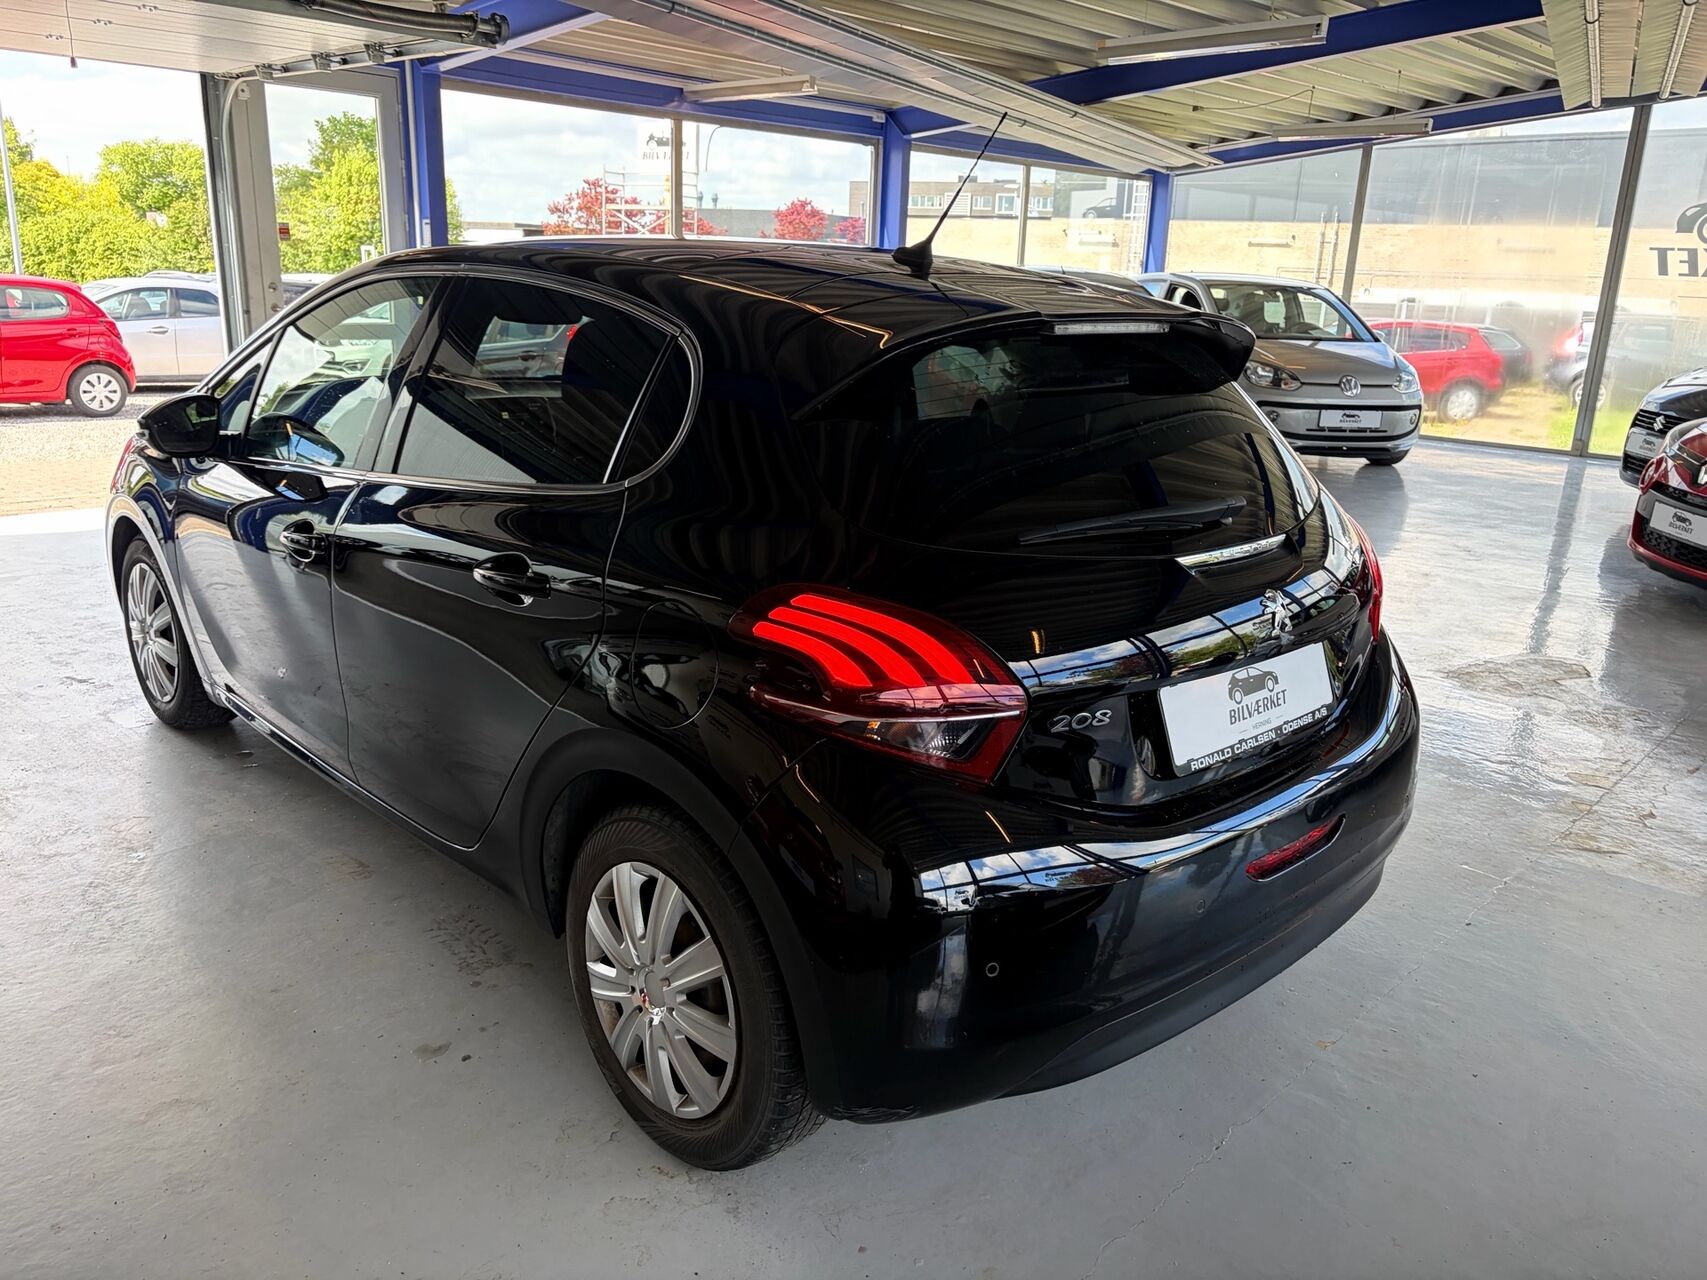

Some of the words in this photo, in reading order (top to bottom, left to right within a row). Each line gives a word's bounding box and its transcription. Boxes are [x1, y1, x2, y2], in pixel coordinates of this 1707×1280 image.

[1050, 709, 1112, 733] 208
[1229, 689, 1287, 725] BILVÆRKET
[1191, 748, 1232, 771] RONALD
[1234, 729, 1276, 754] CARLSEN
[1281, 713, 1313, 734] ODENSE
[1314, 707, 1328, 720] A/S
